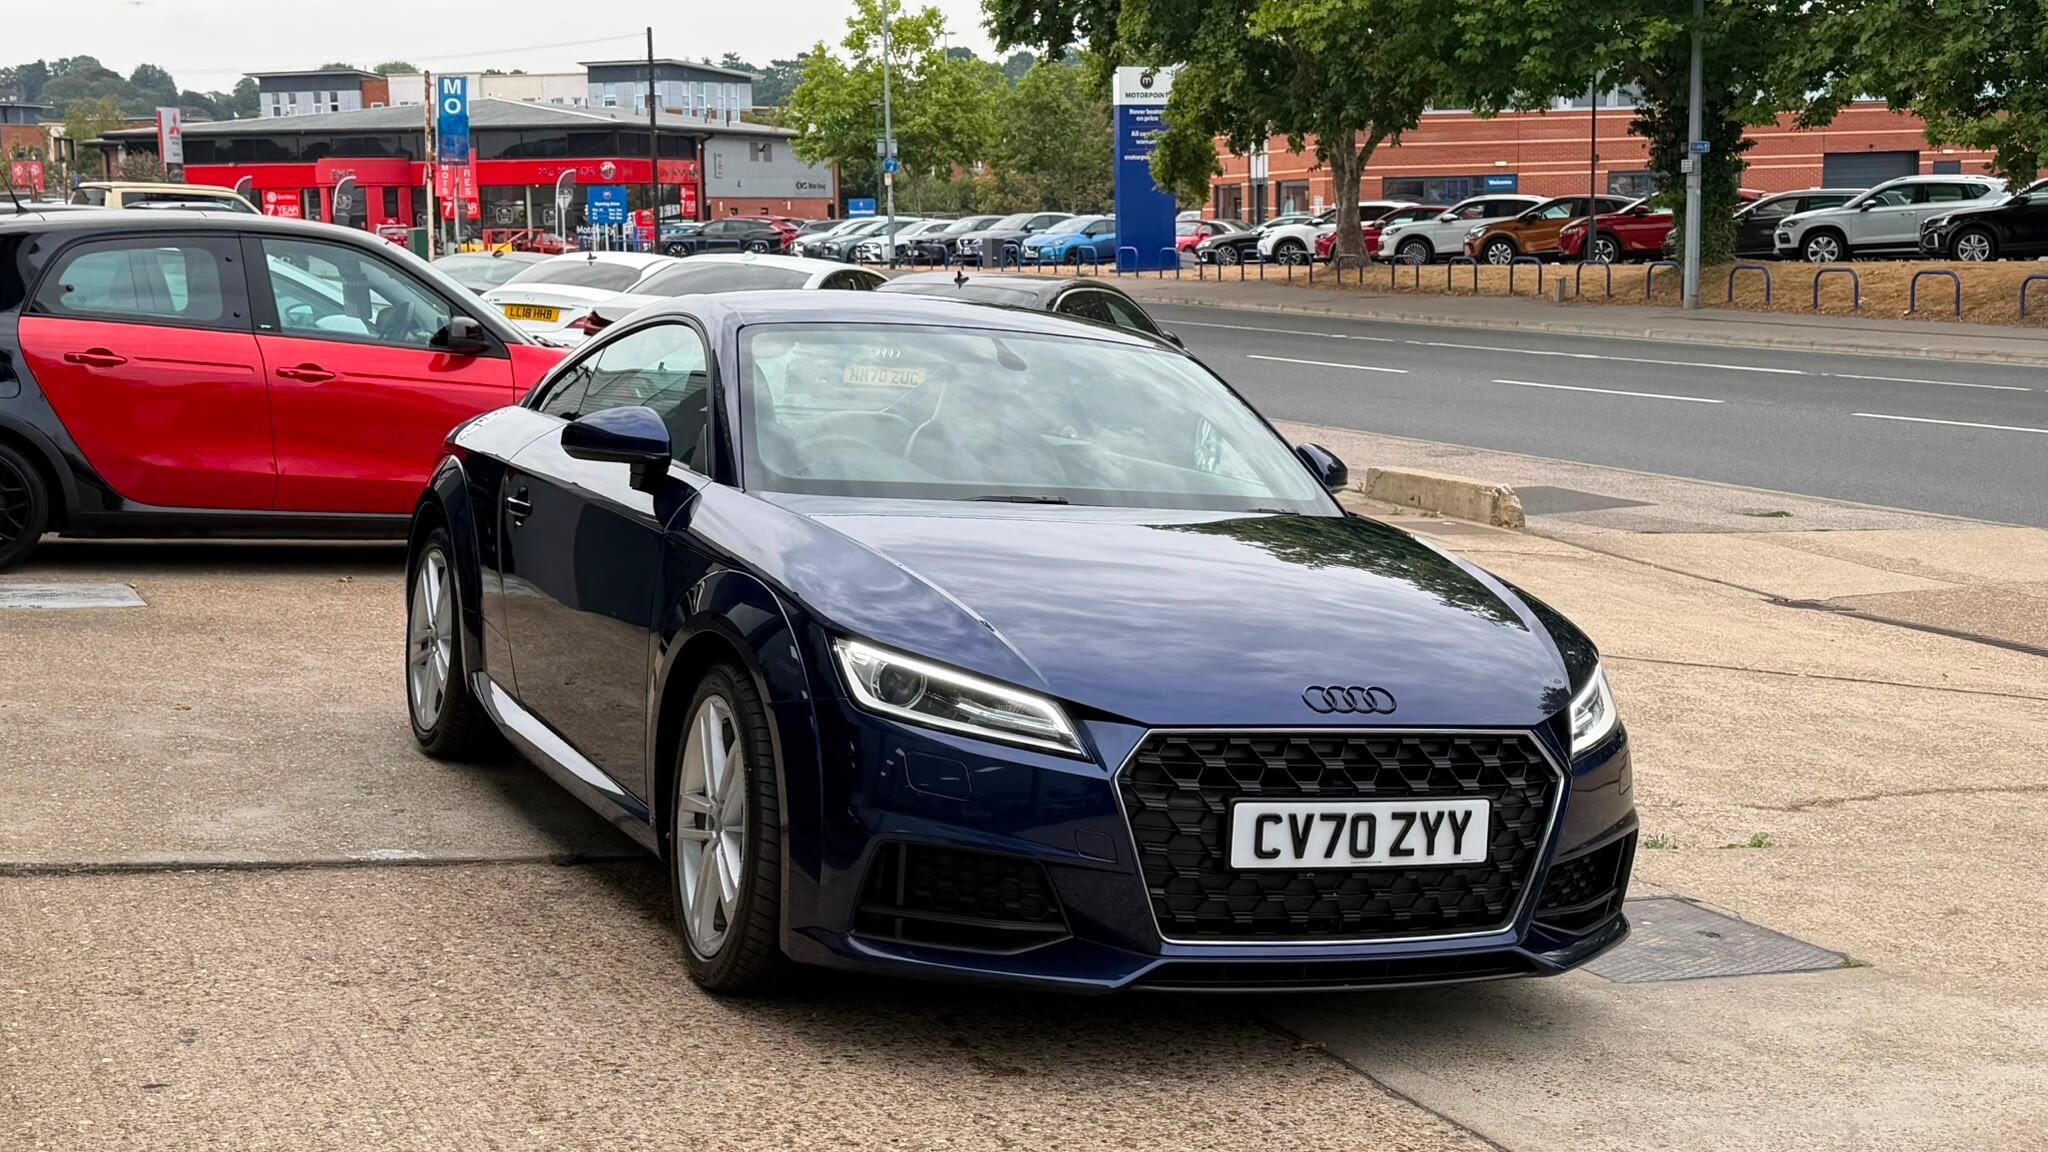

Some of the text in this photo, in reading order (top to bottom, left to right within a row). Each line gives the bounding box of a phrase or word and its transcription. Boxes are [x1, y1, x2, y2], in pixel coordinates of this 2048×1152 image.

[276, 205, 299, 215] YEAR
[509, 306, 532, 318] LL18
[1254, 810, 1473, 859] CV70 ZYY
